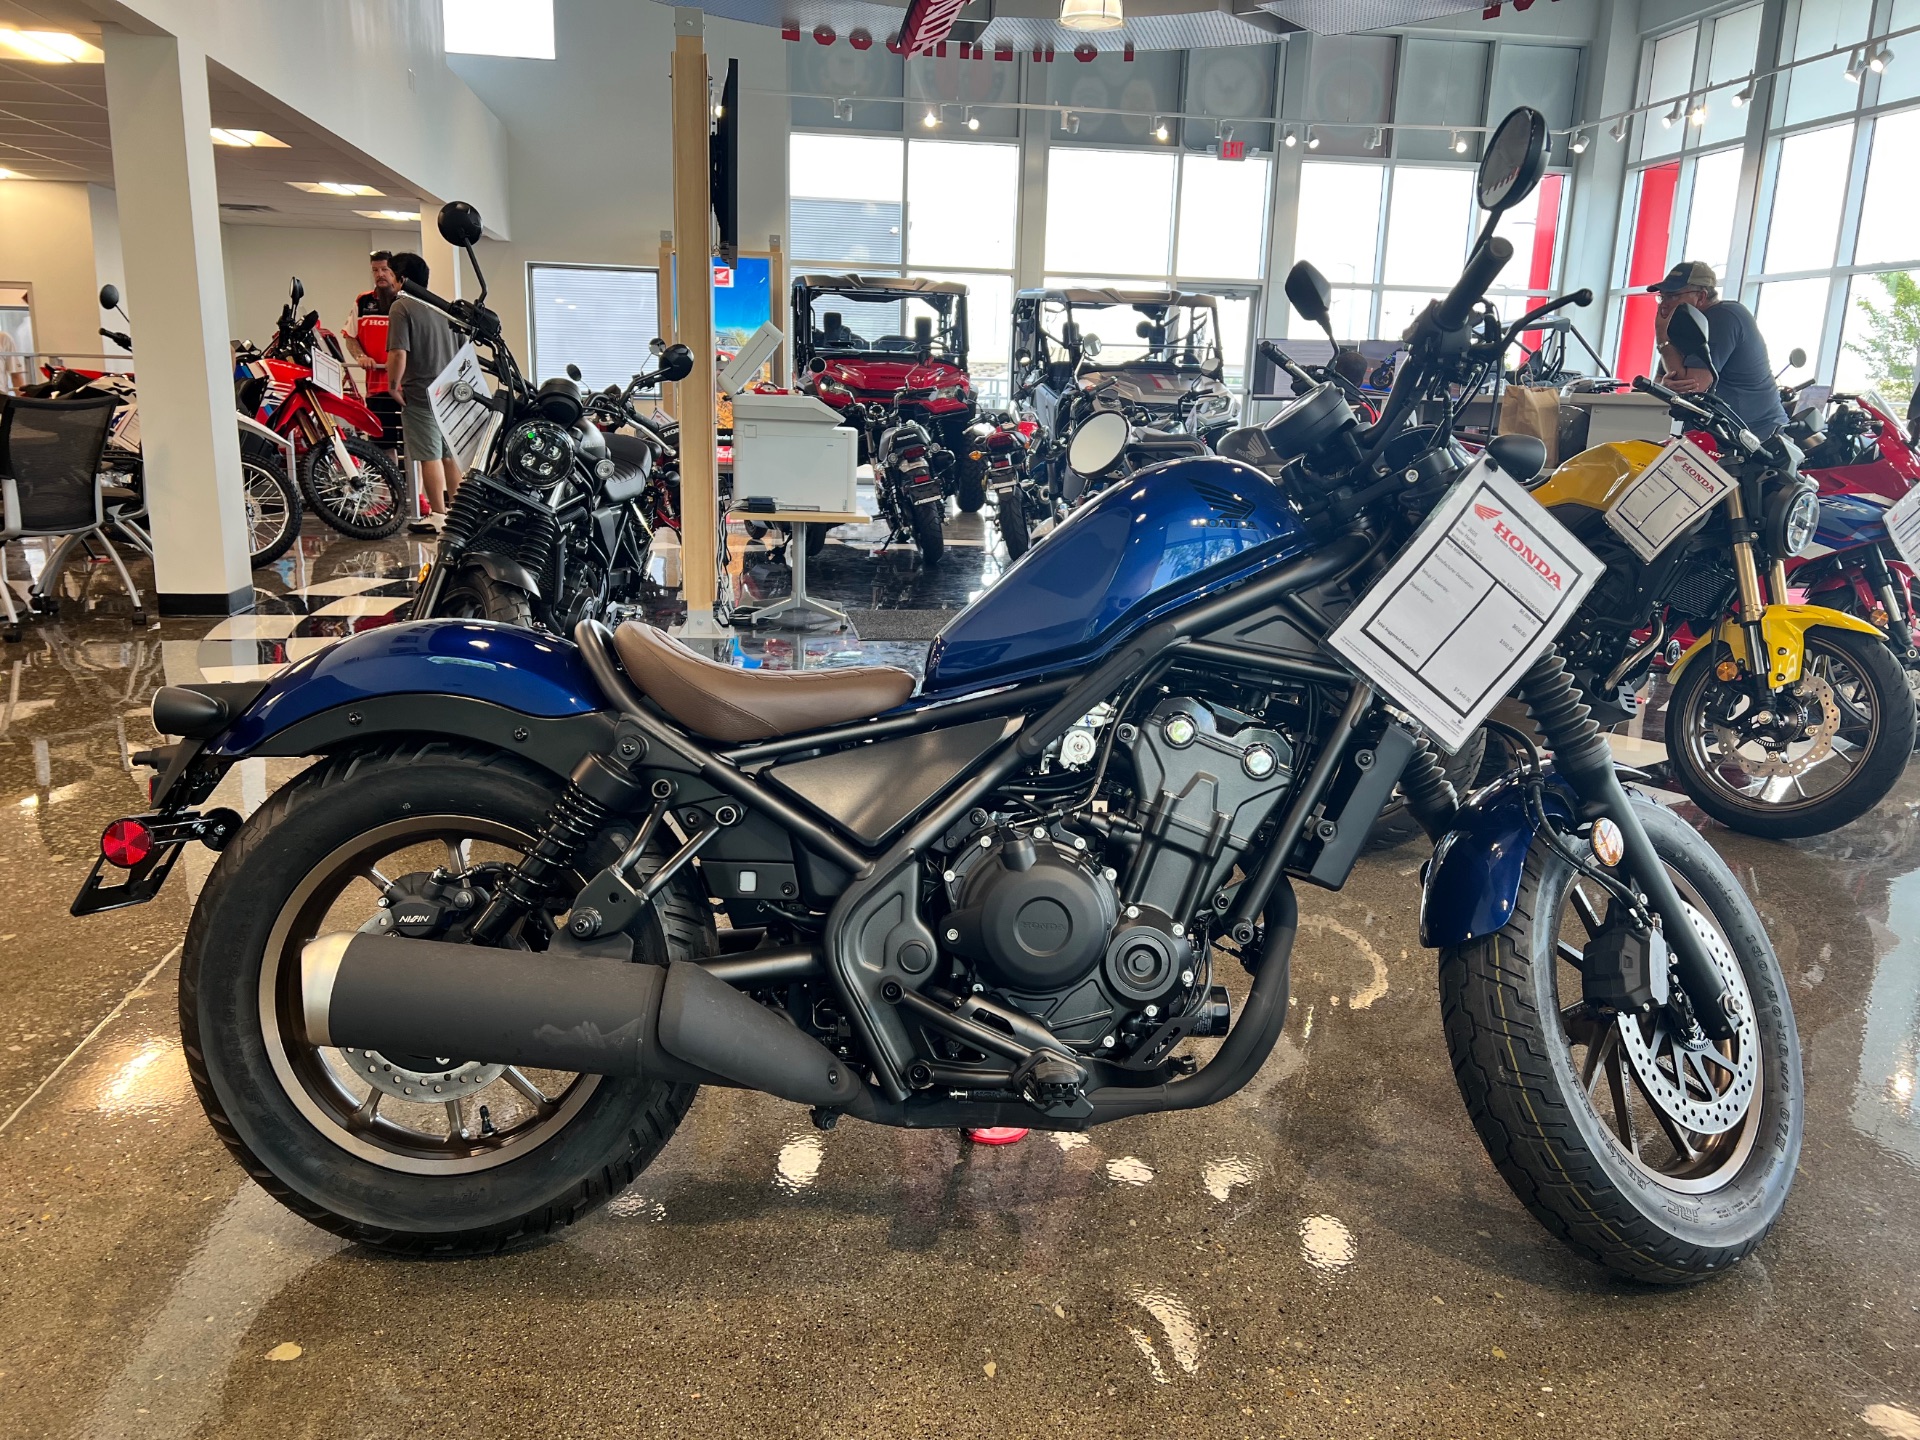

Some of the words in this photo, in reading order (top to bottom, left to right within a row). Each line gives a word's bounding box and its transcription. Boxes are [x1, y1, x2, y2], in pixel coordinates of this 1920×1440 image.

[1222, 141, 1245, 159] EXIT
[1681, 461, 1715, 494] HONDA
[1463, 533, 1477, 546] Honda
[1492, 519, 1562, 591] HONDA
